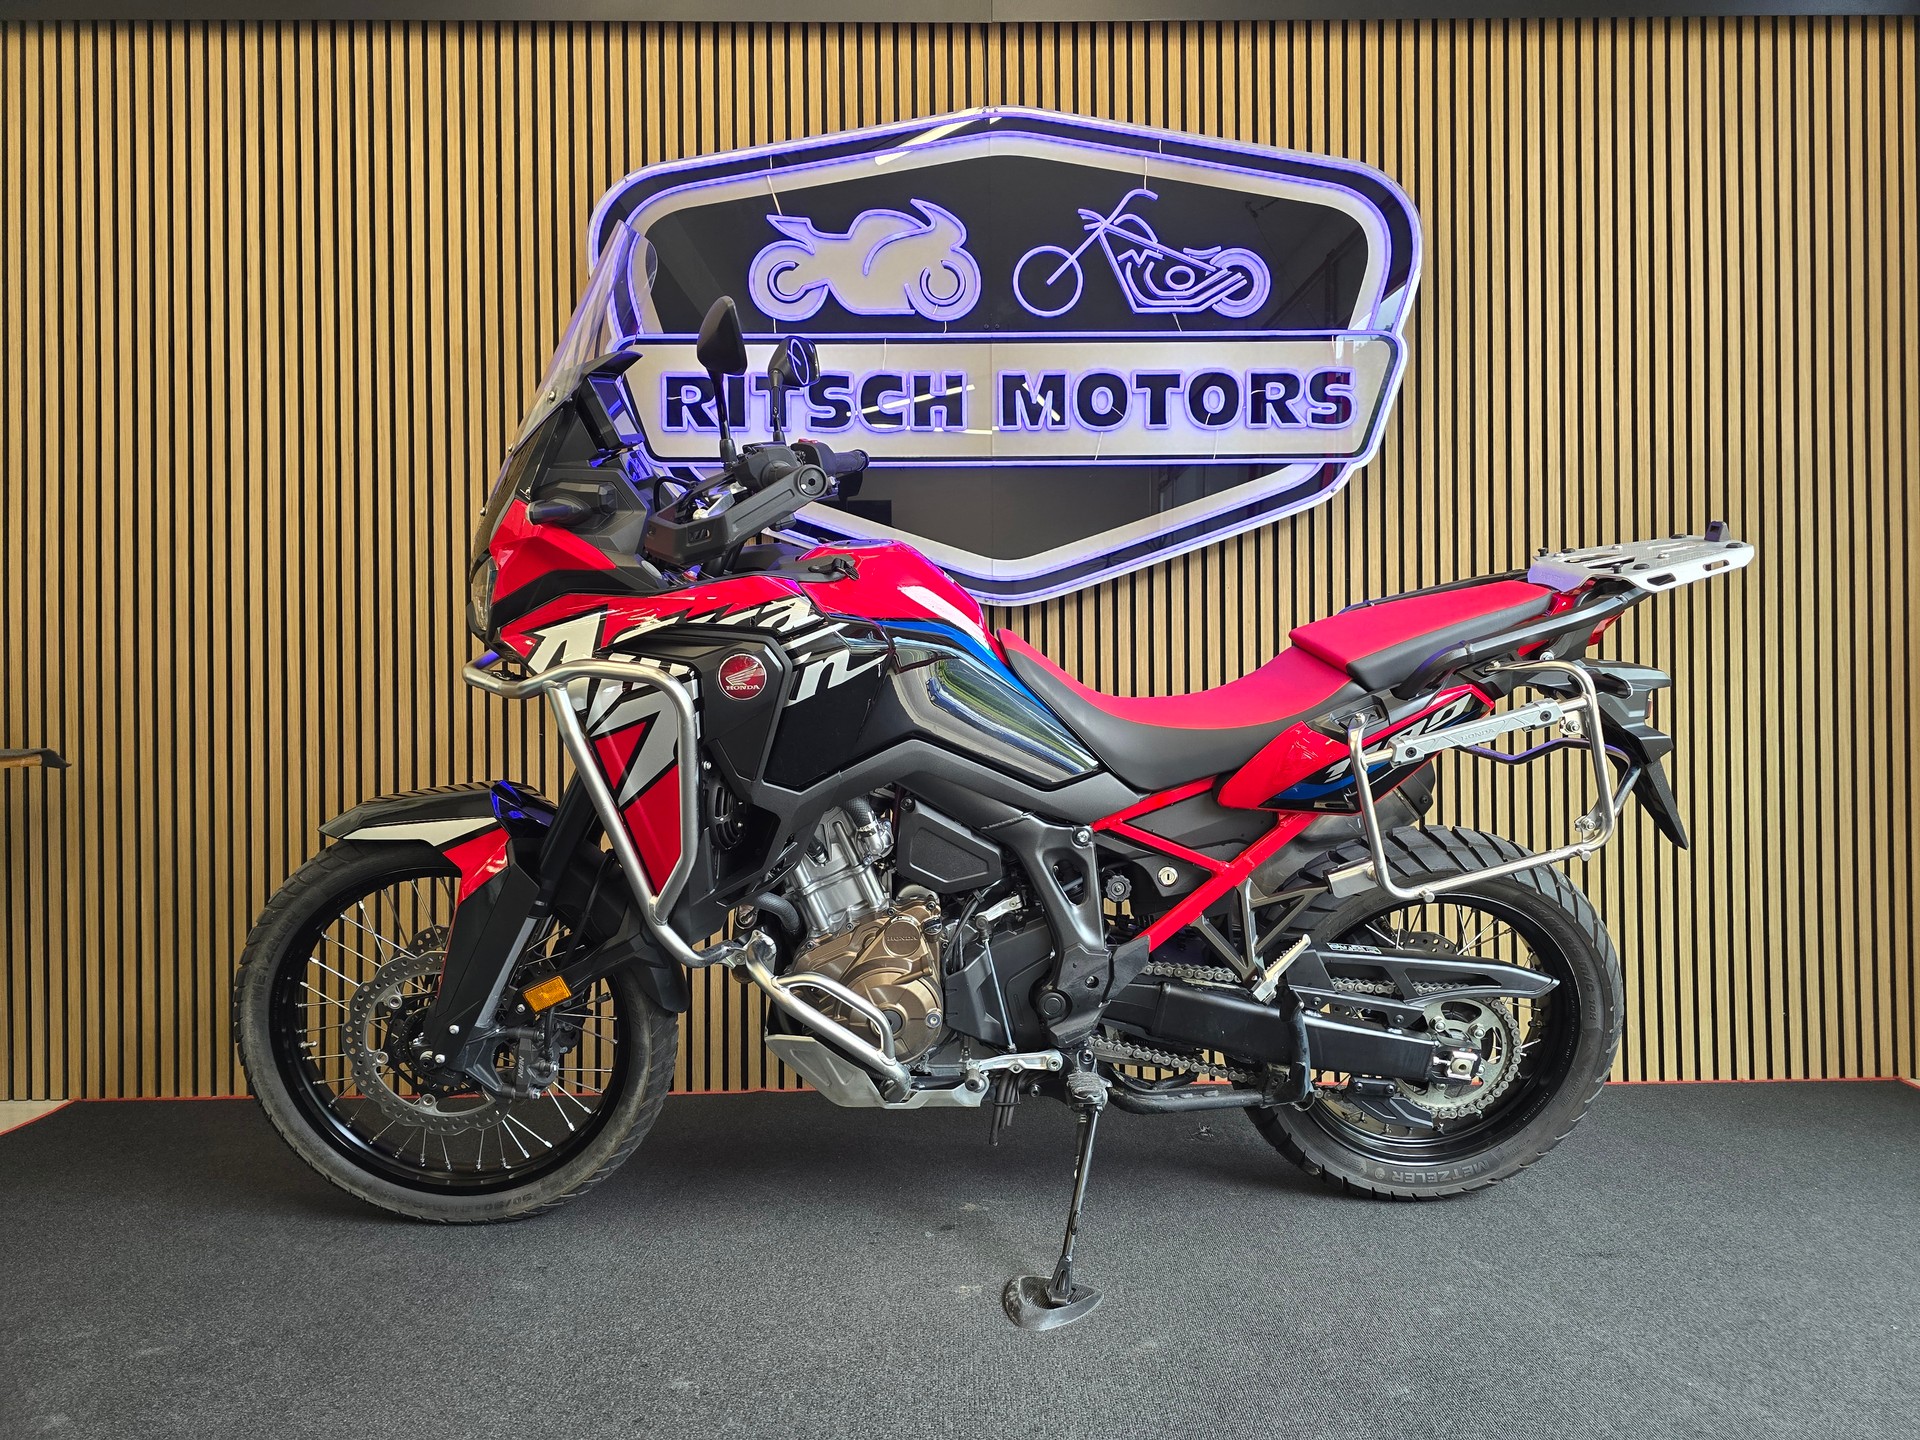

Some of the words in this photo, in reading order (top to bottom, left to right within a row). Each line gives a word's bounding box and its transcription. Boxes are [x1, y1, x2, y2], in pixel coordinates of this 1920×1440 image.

[661, 370, 968, 433] RITSCH
[997, 366, 1358, 432] MOTORS
[1460, 728, 1496, 741] HONDA
[1392, 1160, 1489, 1184] METZELER
